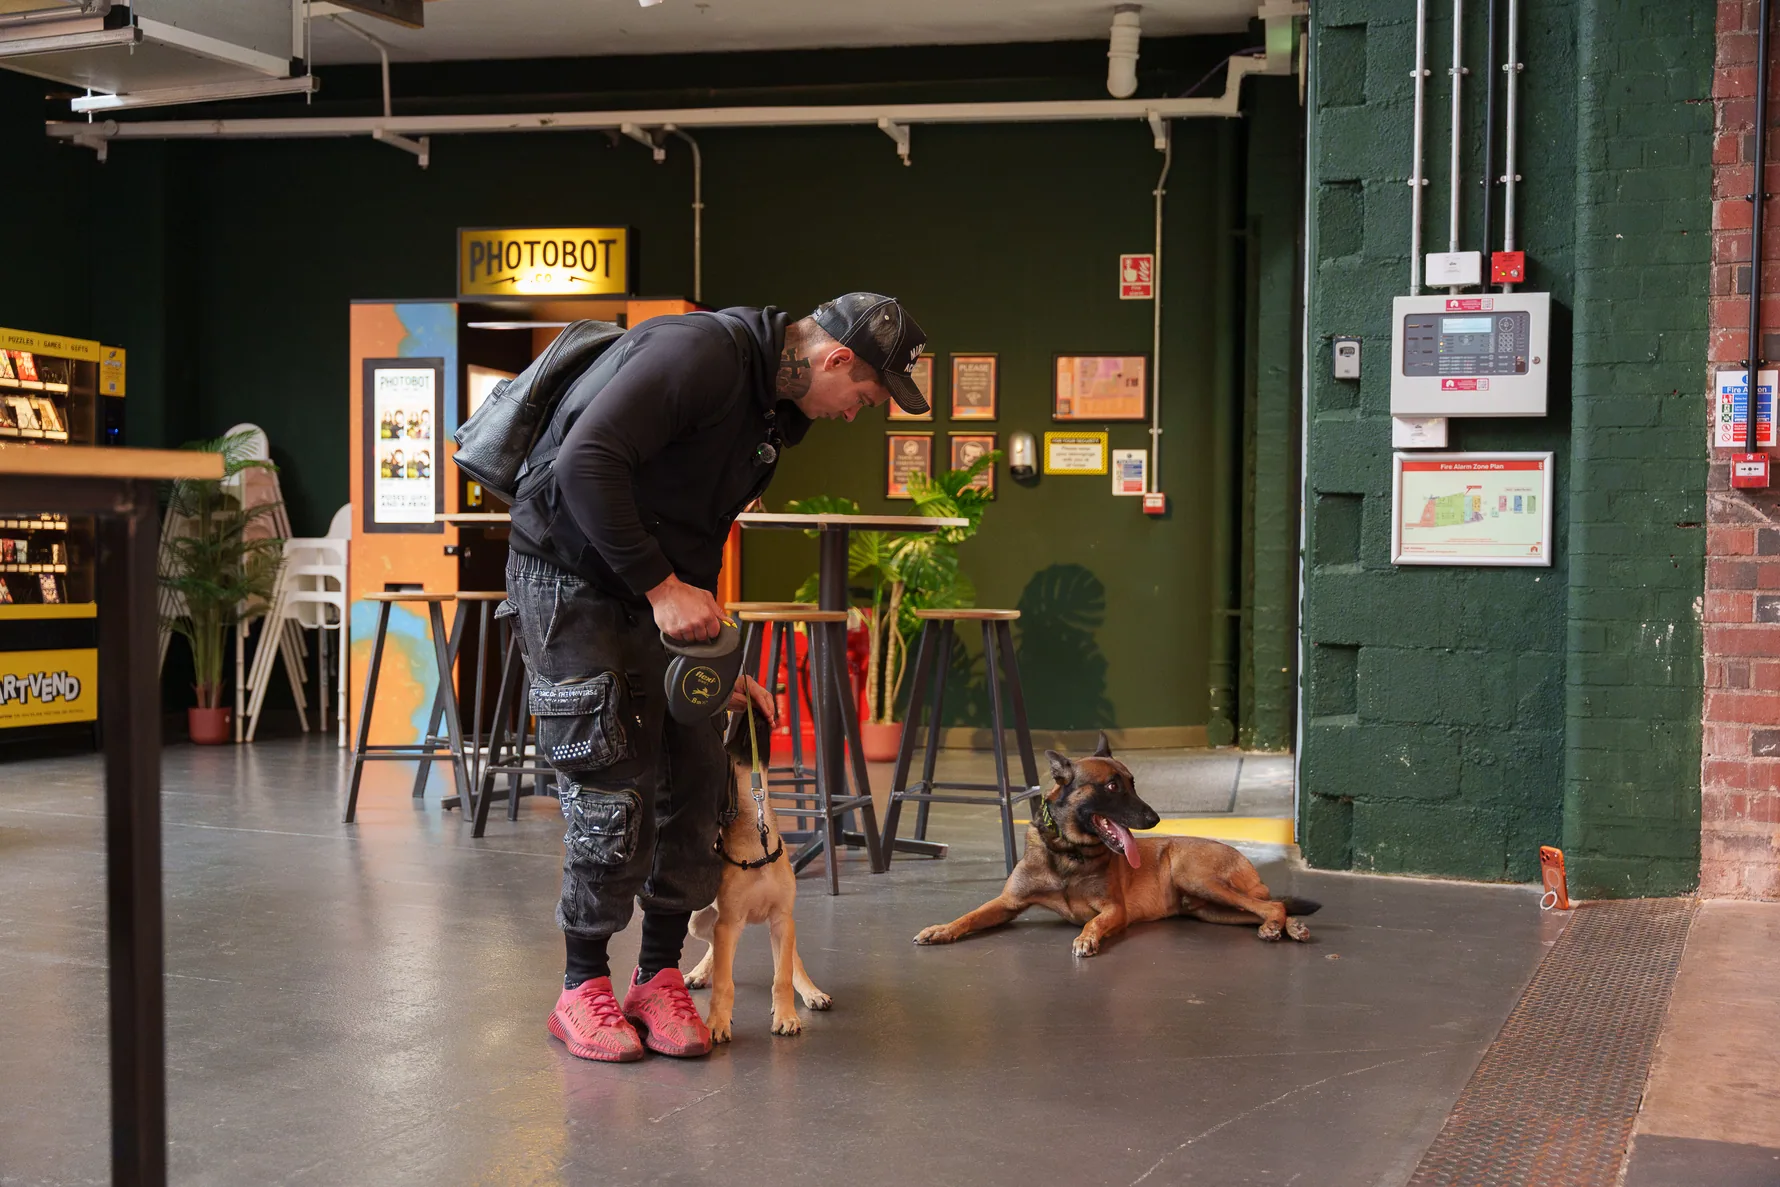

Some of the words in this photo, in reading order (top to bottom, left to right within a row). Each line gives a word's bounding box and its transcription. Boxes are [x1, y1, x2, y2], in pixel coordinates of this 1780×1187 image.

[469, 239, 617, 283] PHOTOBOT
[8, 336, 34, 346] PUZZLES
[43, 341, 61, 349] GAMES
[70, 344, 89, 353] GIFTS
[958, 363, 989, 373] PLEASE
[380, 375, 430, 390] PHOTOBOT
[695, 670, 715, 683] flexi
